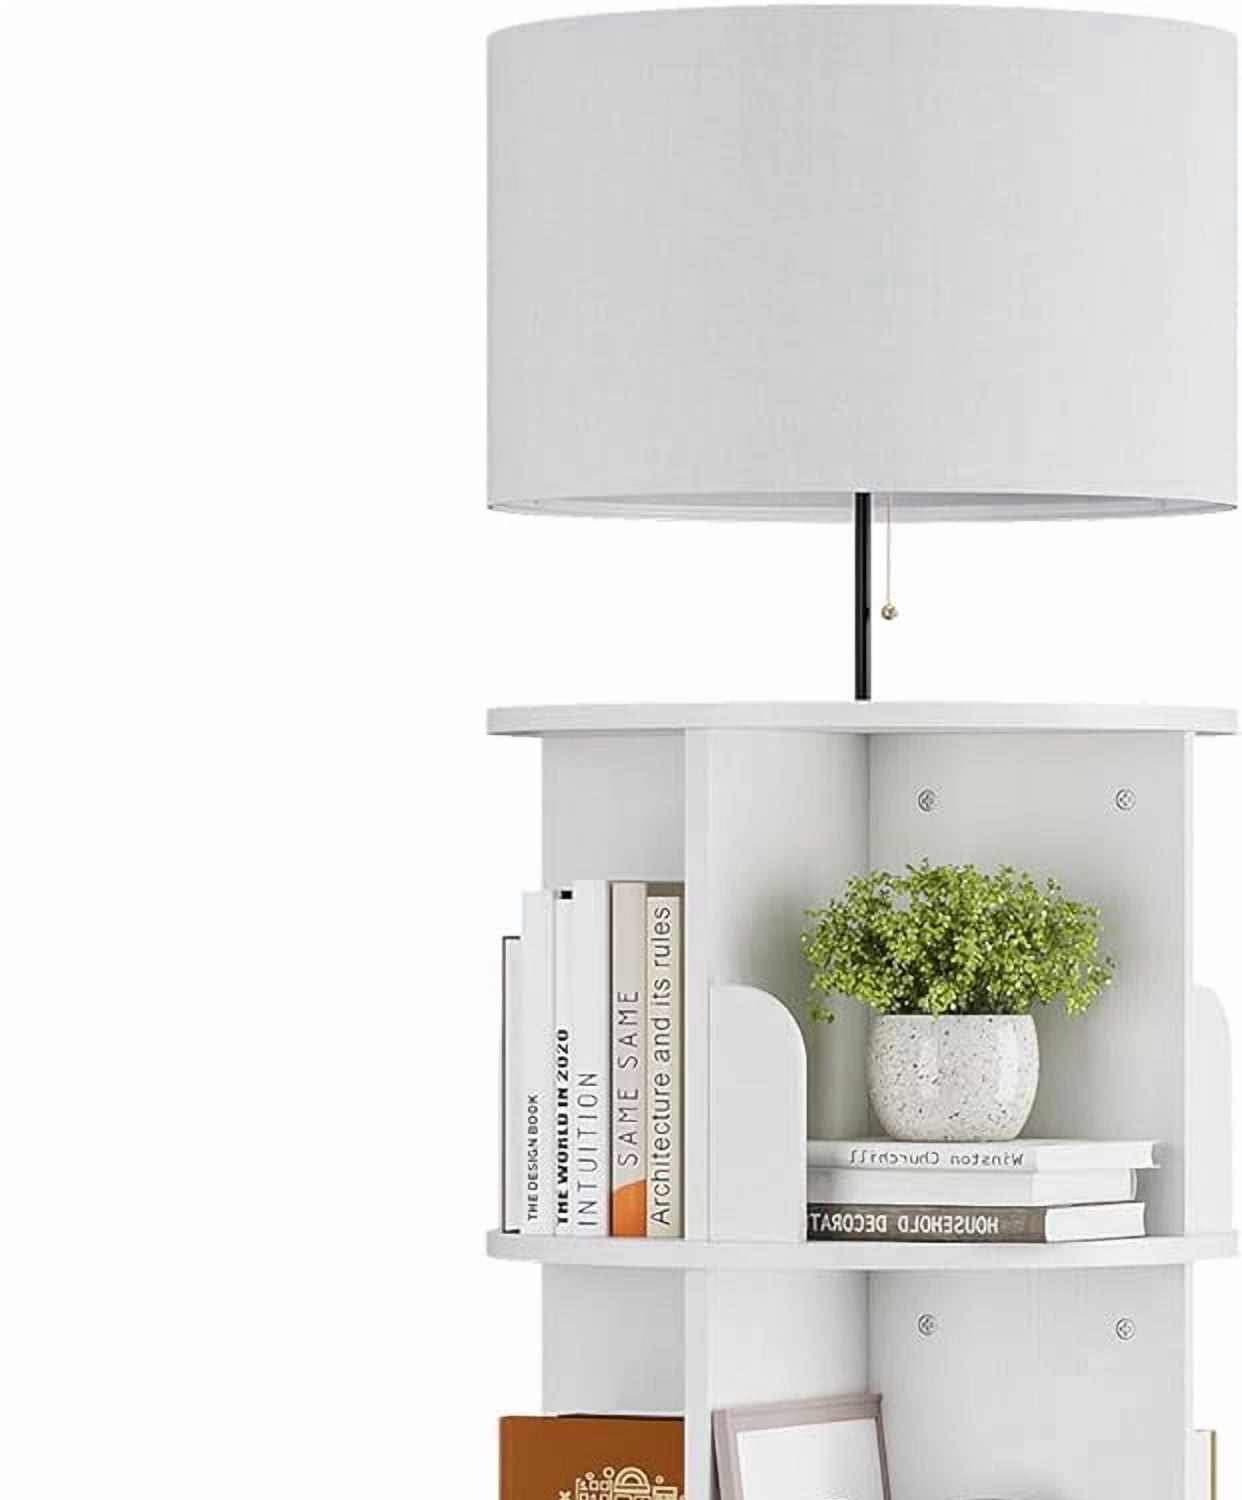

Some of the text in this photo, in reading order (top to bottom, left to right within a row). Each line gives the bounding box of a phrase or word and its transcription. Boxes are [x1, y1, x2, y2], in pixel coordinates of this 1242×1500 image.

[557, 1029, 570, 1082] 2020
[617, 990, 639, 1167] SAME SAME
[650, 906, 672, 1225] Architecture and its rules
[527, 1094, 539, 1221] THE DESIGN BOOK
[557, 1113, 570, 1184] WORLD
[557, 1190, 570, 1225] THE
[576, 1073, 598, 1226] INTUITION
